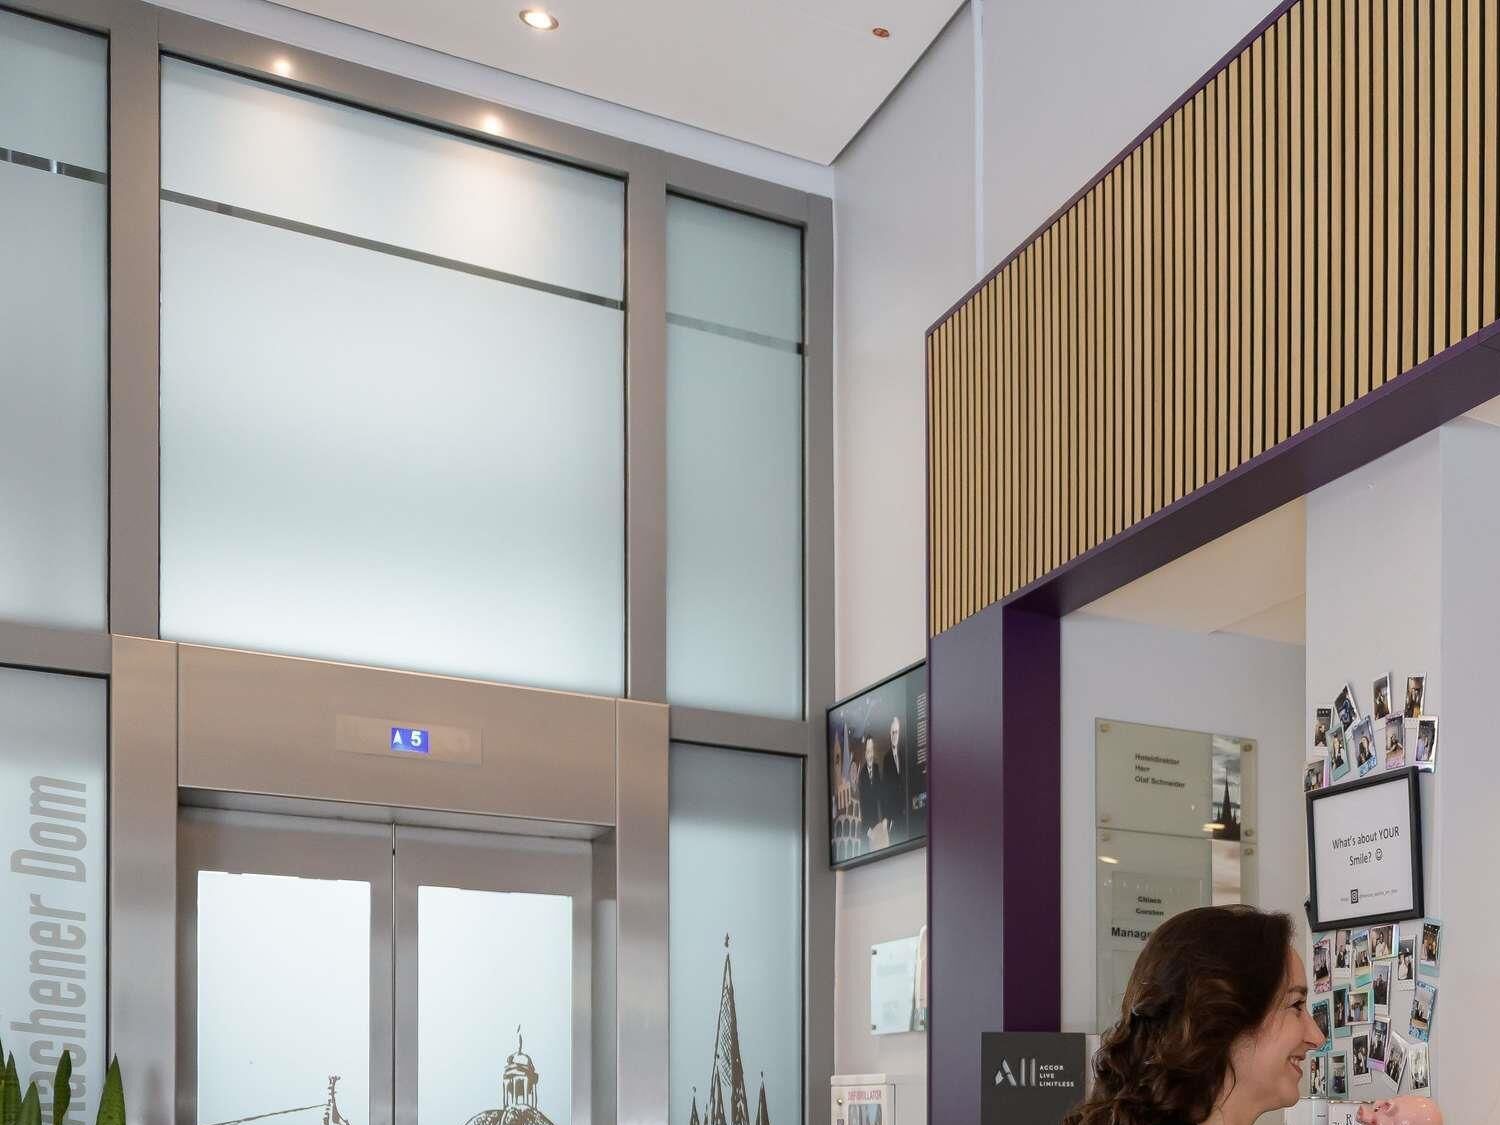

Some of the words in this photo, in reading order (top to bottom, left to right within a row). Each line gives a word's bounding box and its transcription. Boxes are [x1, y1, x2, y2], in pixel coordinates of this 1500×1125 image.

[410, 730, 422, 747] 5
[10, 775, 87, 882] Dom
[1332, 835, 1356, 850] What's
[1357, 831, 1377, 846] about
[1379, 826, 1400, 840] YOUR
[1349, 851, 1372, 866] Smile?
